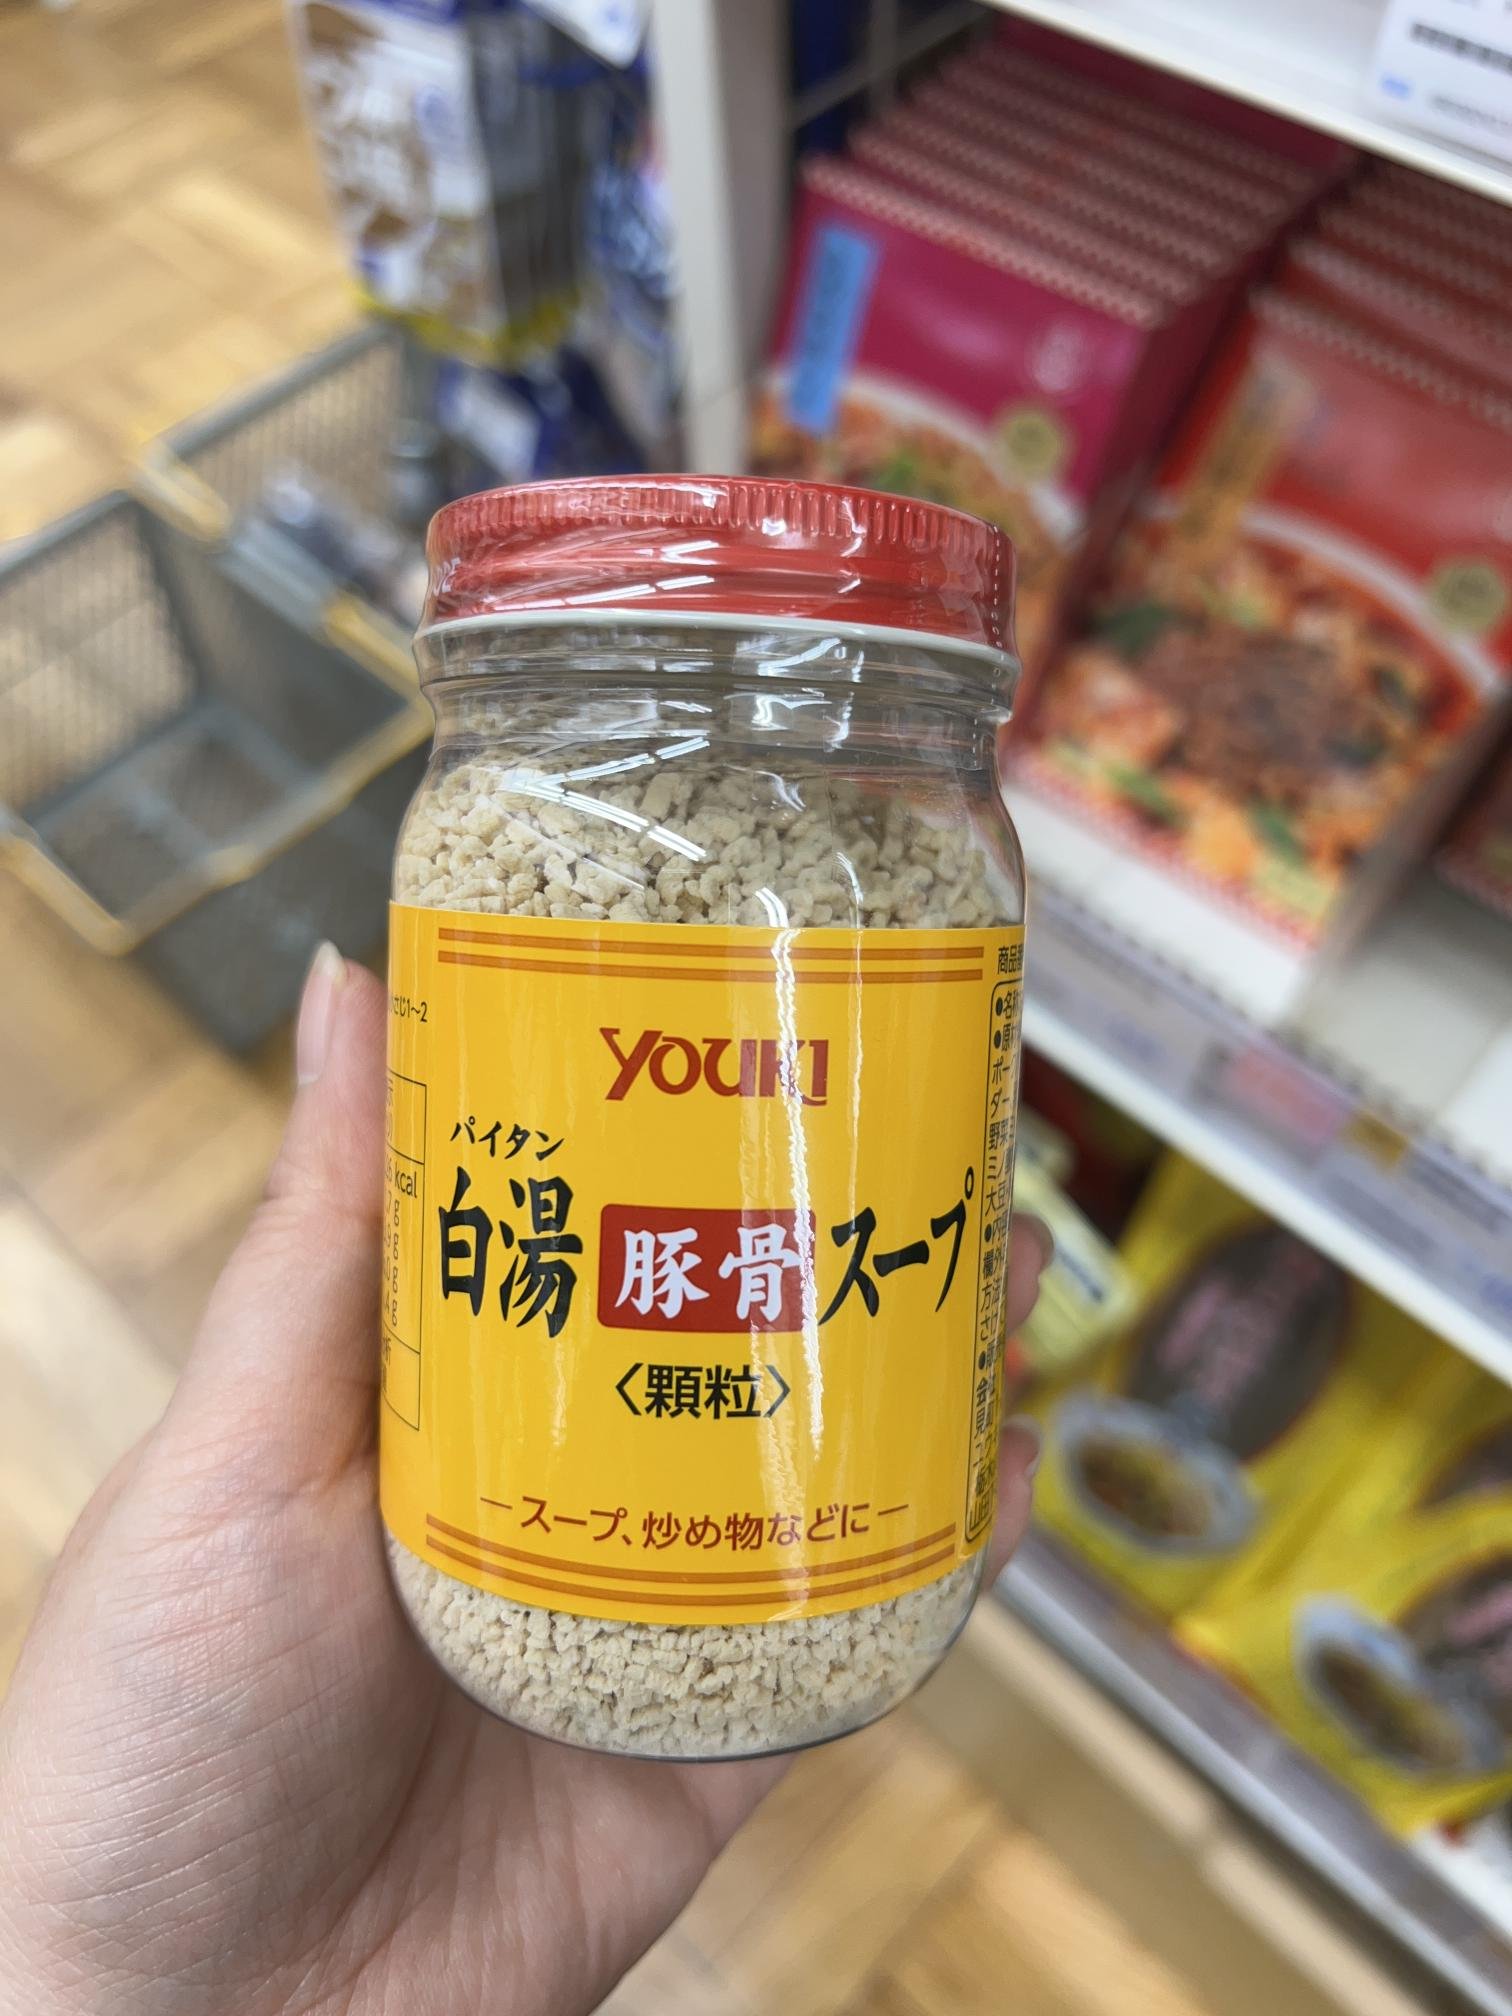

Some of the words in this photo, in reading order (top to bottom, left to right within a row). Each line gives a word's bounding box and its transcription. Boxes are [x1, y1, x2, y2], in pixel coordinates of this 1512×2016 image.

[450, 1116, 565, 1161] パイタン
[394, 1161, 418, 1199] kcal
[438, 1166, 583, 1338] 白湯
[614, 1222, 802, 1323] 豚骨
[818, 1166, 974, 1326] スープ
